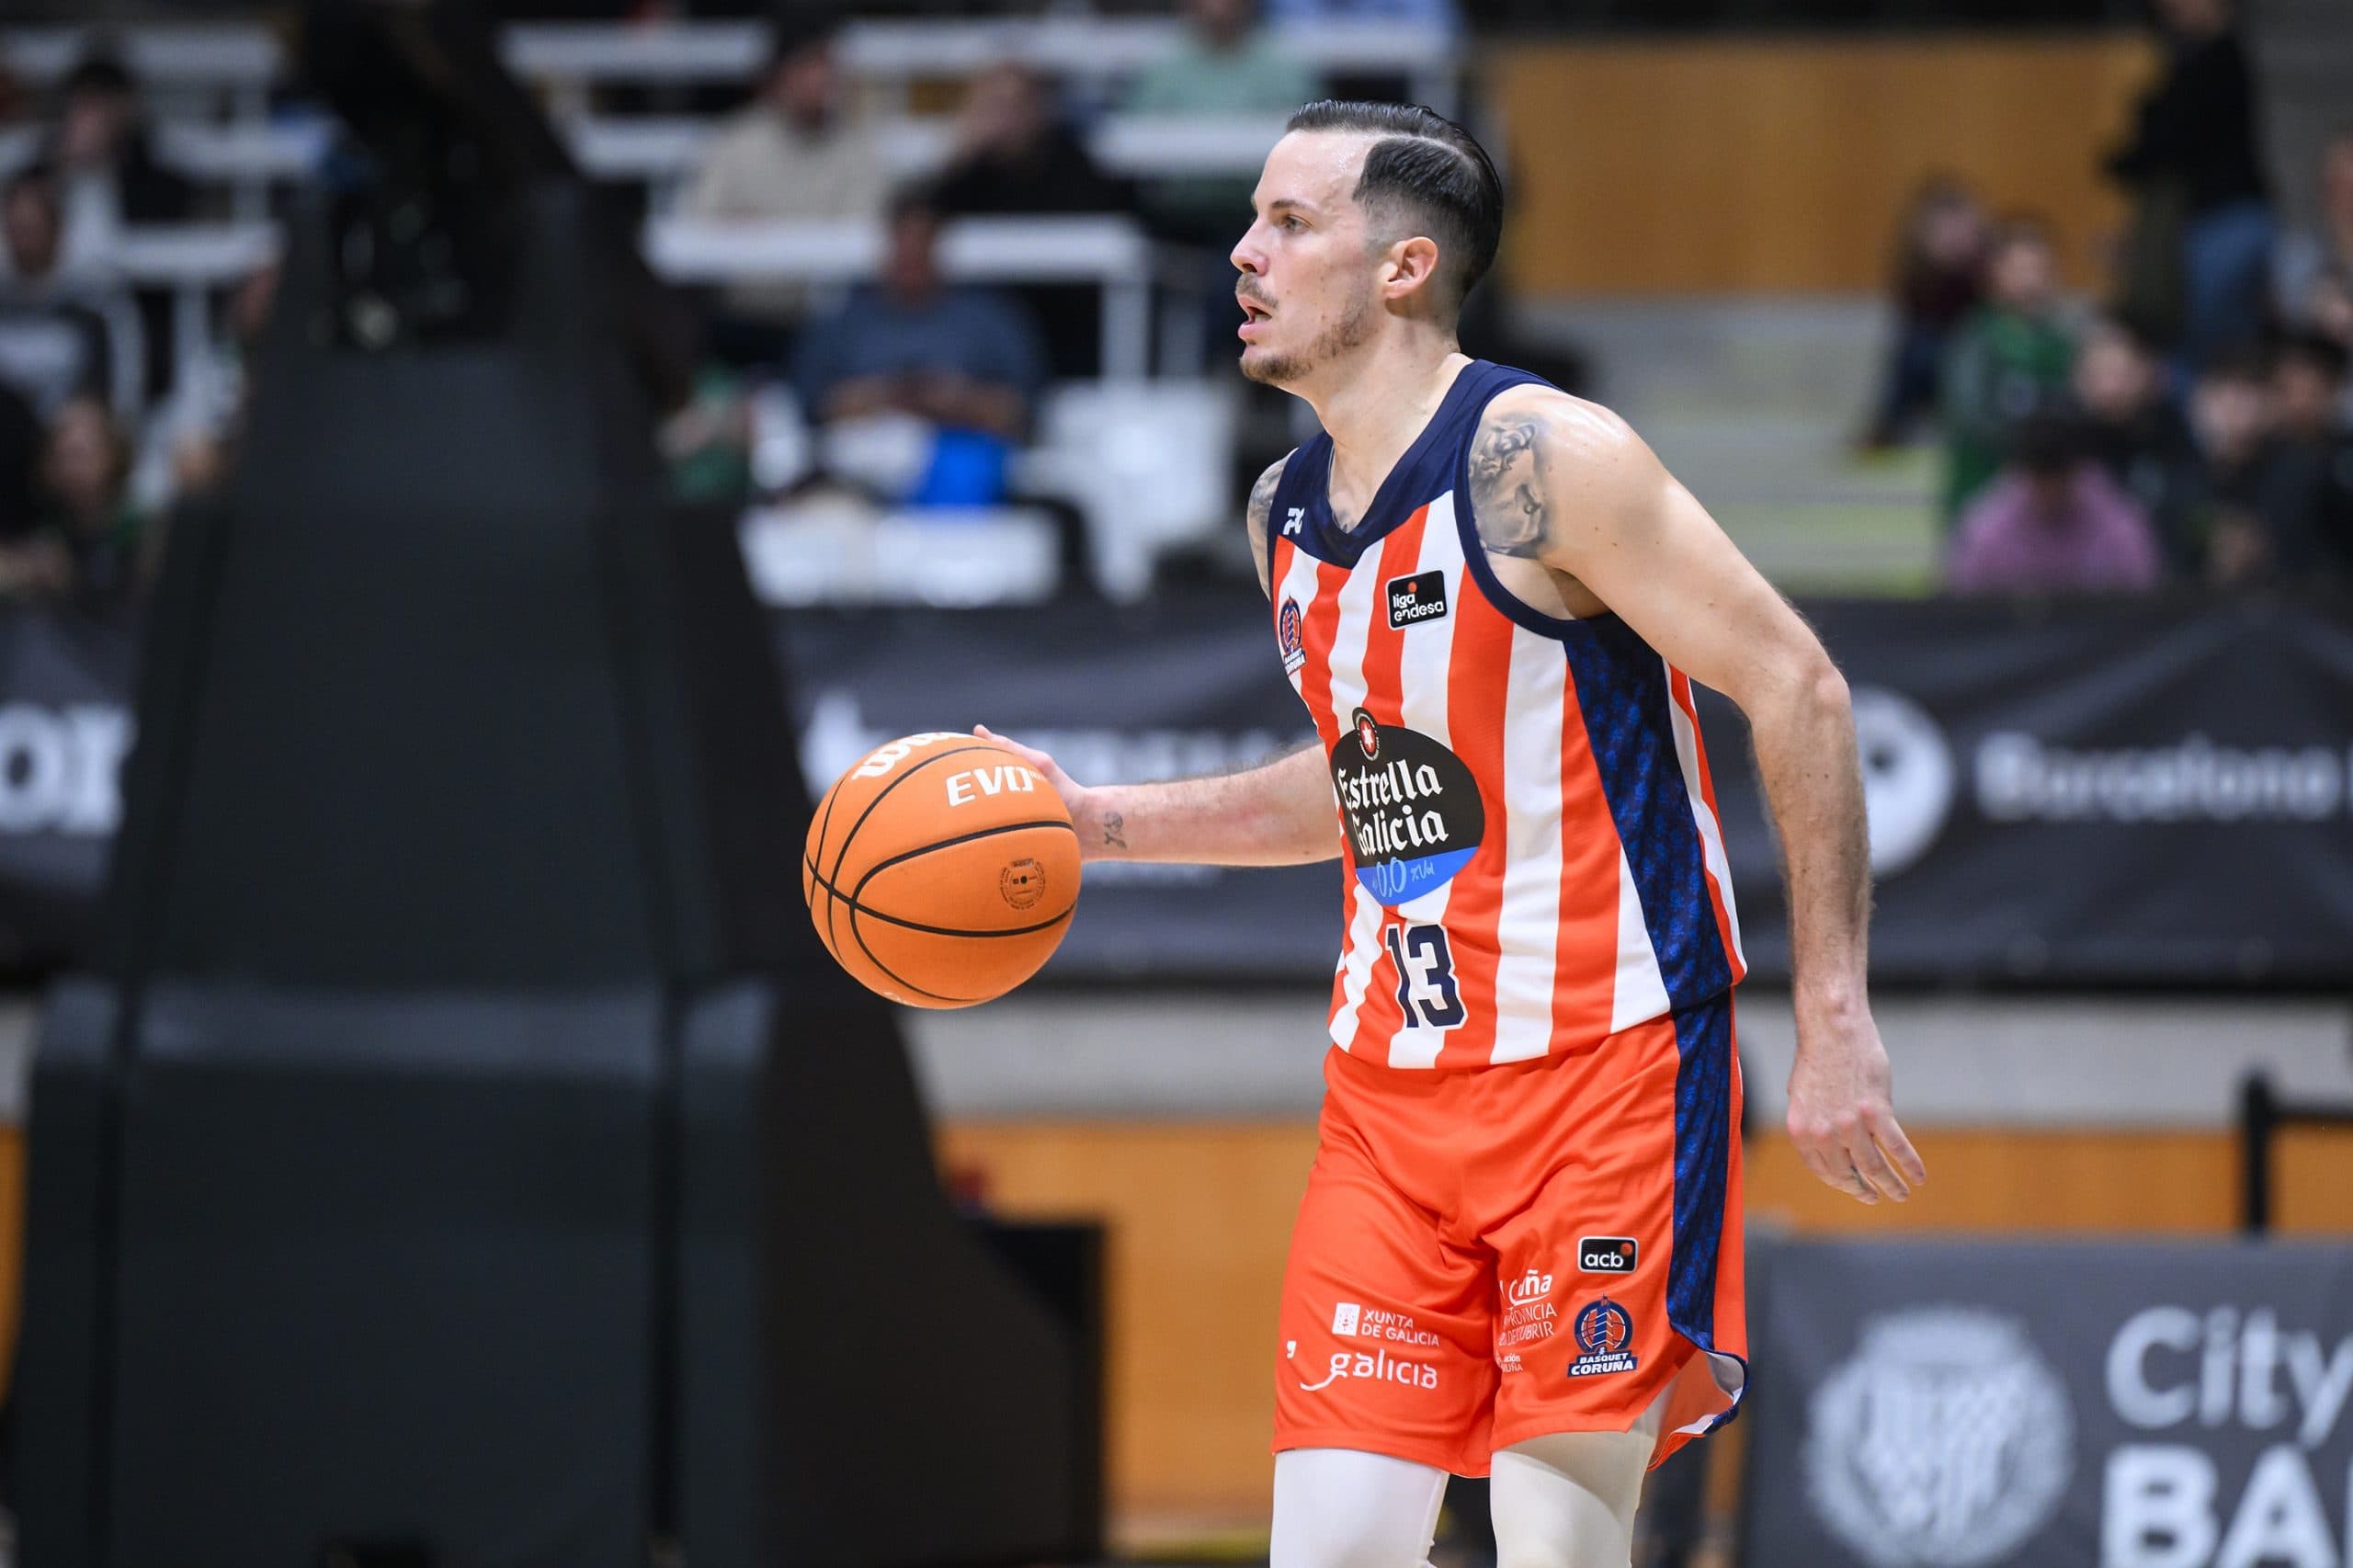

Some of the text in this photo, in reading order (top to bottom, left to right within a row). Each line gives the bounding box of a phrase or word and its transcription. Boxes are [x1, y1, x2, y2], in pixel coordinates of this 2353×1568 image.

[1392, 593, 1415, 608] liga
[1394, 601, 1444, 621] endesa
[946, 766, 1034, 806] EVO
[1338, 759, 1443, 811] Estrella
[1352, 805, 1449, 857] Galicia
[1386, 924, 1467, 1028] 13
[1585, 1252, 1623, 1267] acb
[1361, 1323, 1439, 1346] DE GALICIA
[1364, 1309, 1414, 1329] XUNTA
[1300, 1348, 1438, 1391] galicia
[1579, 1353, 1629, 1365] BASQUET
[2106, 1304, 2353, 1449] City
[2101, 1443, 2353, 1568] BA
